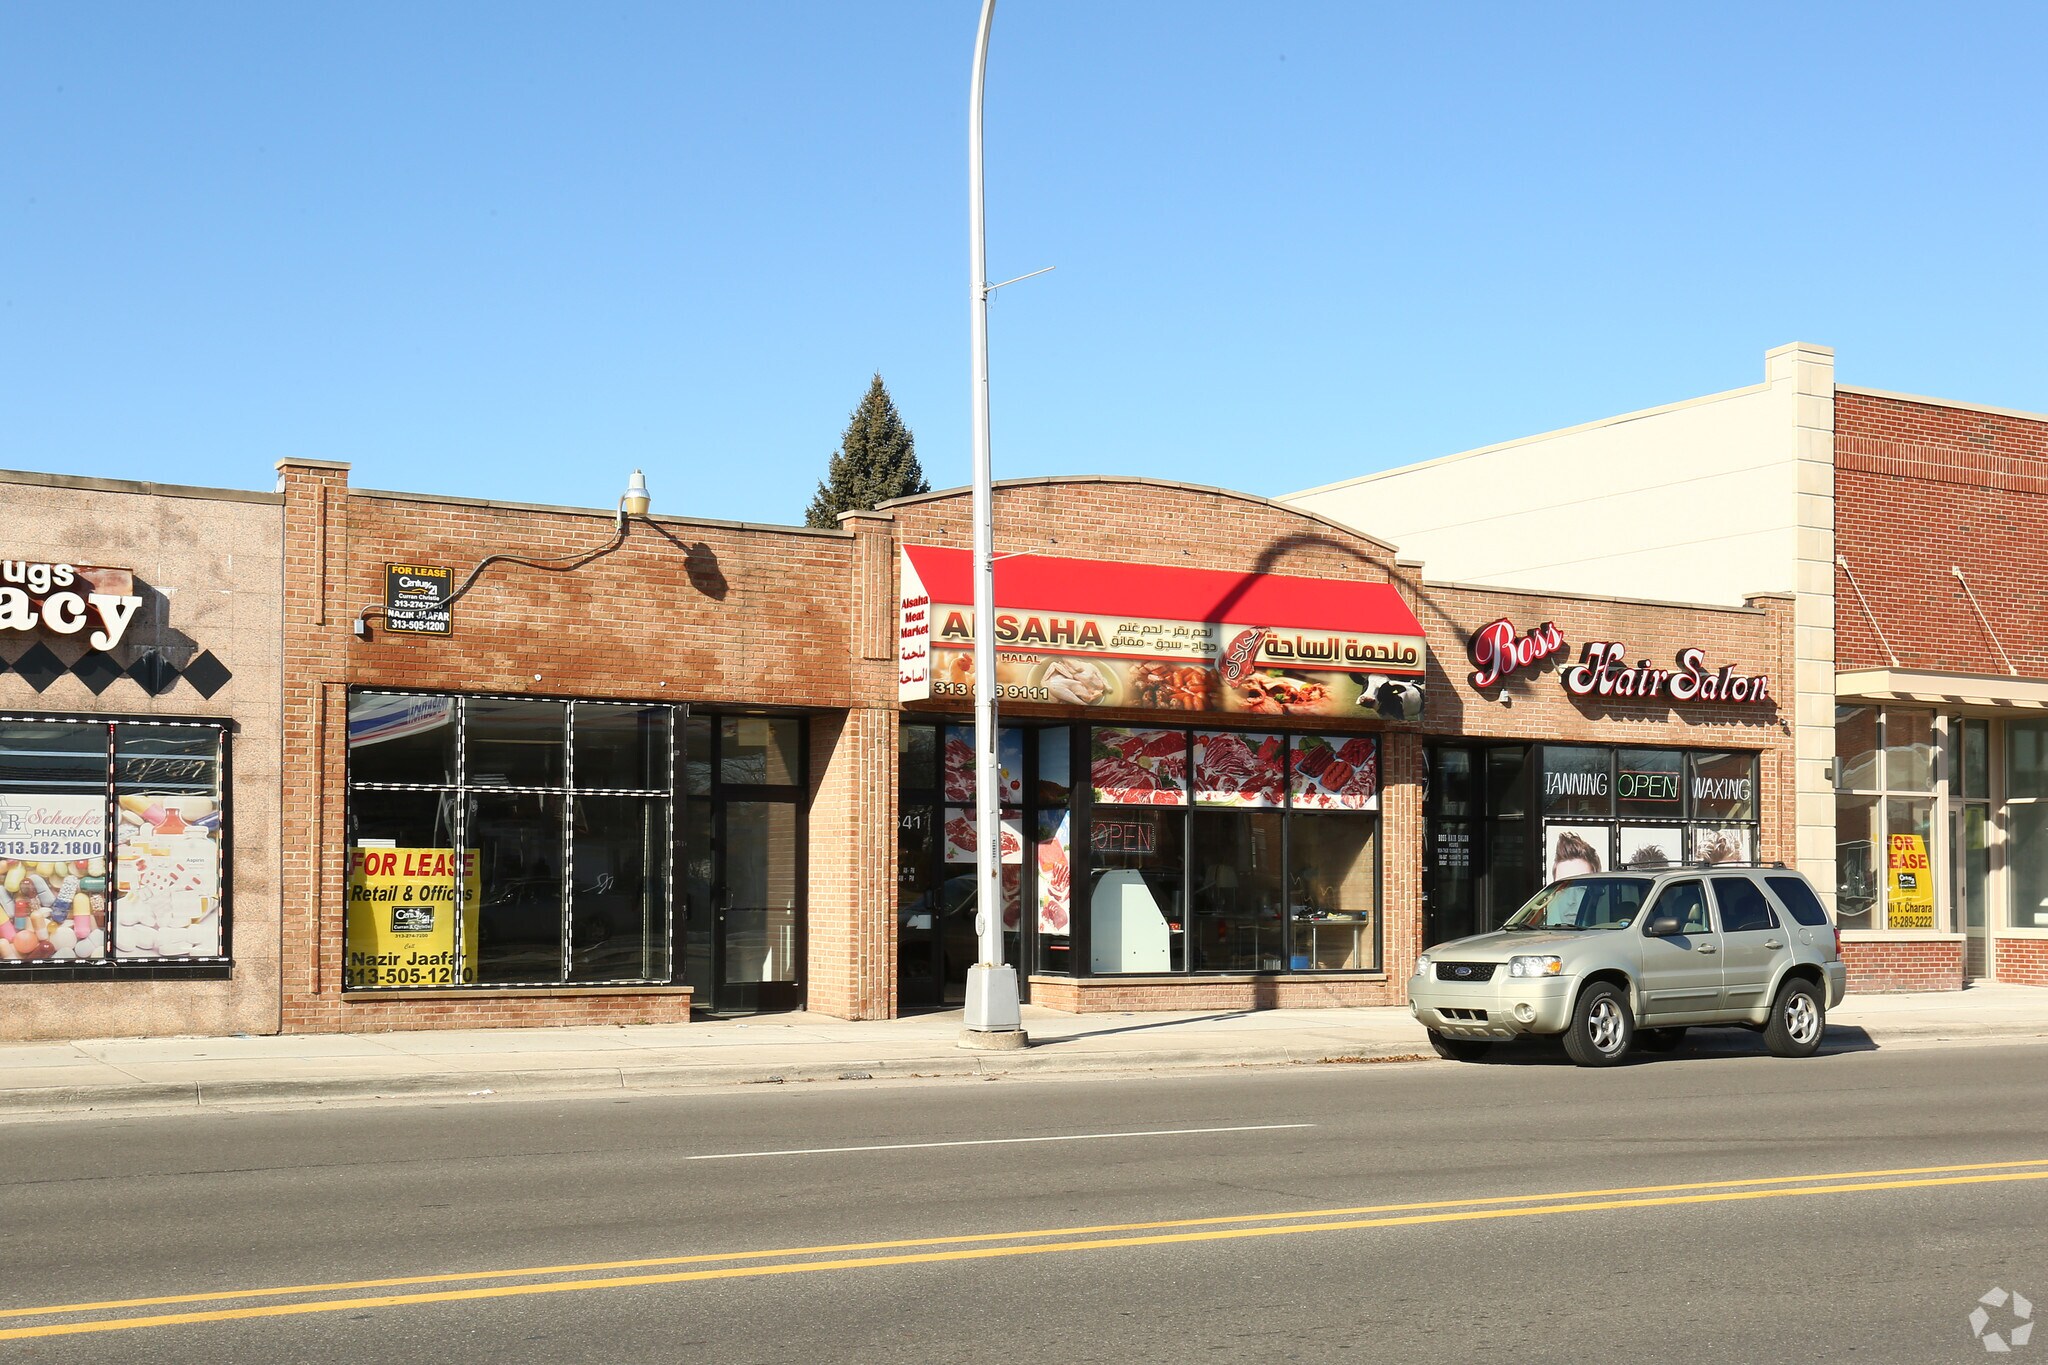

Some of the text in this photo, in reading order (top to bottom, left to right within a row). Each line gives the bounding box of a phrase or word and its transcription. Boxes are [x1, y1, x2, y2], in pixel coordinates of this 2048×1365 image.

[392, 566, 447, 578] FOR LEASE
[901, 595, 928, 609] Alsaha
[0, 586, 142, 651] acy
[416, 611, 450, 622] JAAFAR
[905, 610, 924, 623] Meat
[392, 619, 445, 632] 313-505-1200
[901, 624, 928, 638] Market
[941, 611, 1104, 647] ASAHA
[1117, 622, 1140, 634] غنم
[1141, 624, 1163, 636] لحم
[1172, 626, 1189, 637] بقر
[1191, 628, 1213, 639] لحم
[1154, 638, 1182, 651] سجق
[1191, 641, 1218, 654] دجاج
[1264, 633, 1418, 664] ملحمة الساحة
[1001, 653, 1041, 664] HALAL
[1475, 618, 1563, 687] Boss
[1568, 641, 1769, 700] Hair Salon
[934, 681, 967, 695] 313
[1008, 685, 1049, 700] 9111
[1544, 772, 1607, 796] TANNING
[1617, 774, 1677, 798] OPEN
[1692, 777, 1750, 800] WAXING
[28, 807, 103, 829] Schaefer
[898, 815, 920, 830] 41
[34, 829, 101, 838] PHARMACY
[1095, 823, 1151, 850] OPEN
[0, 841, 102, 855] 313.582.1800
[349, 852, 397, 876] FOR
[1887, 853, 1927, 869] EASE
[351, 885, 473, 901] Retail & Offics
[1905, 902, 1933, 913] Charara
[351, 952, 400, 966] Nazir
[346, 967, 473, 984] 313-505-120
